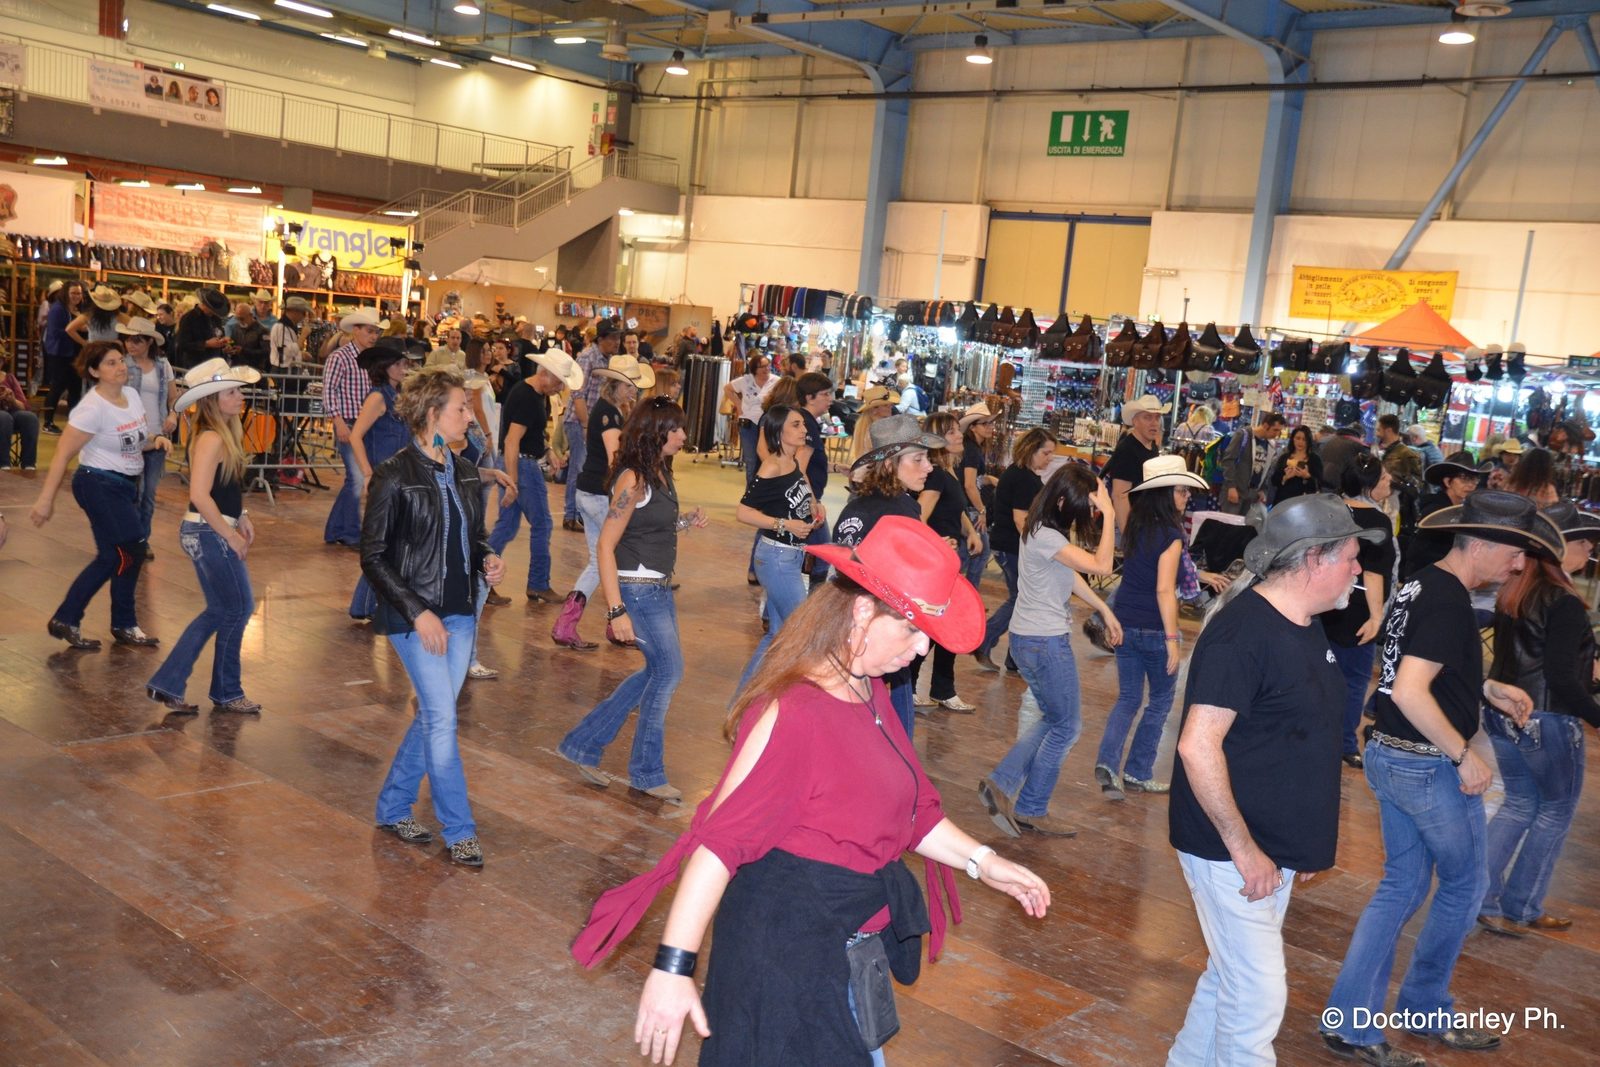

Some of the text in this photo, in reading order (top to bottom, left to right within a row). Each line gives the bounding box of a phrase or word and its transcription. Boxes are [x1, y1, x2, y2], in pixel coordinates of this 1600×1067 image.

[1048, 146, 1122, 154] USCITA DI EMERGENZA
